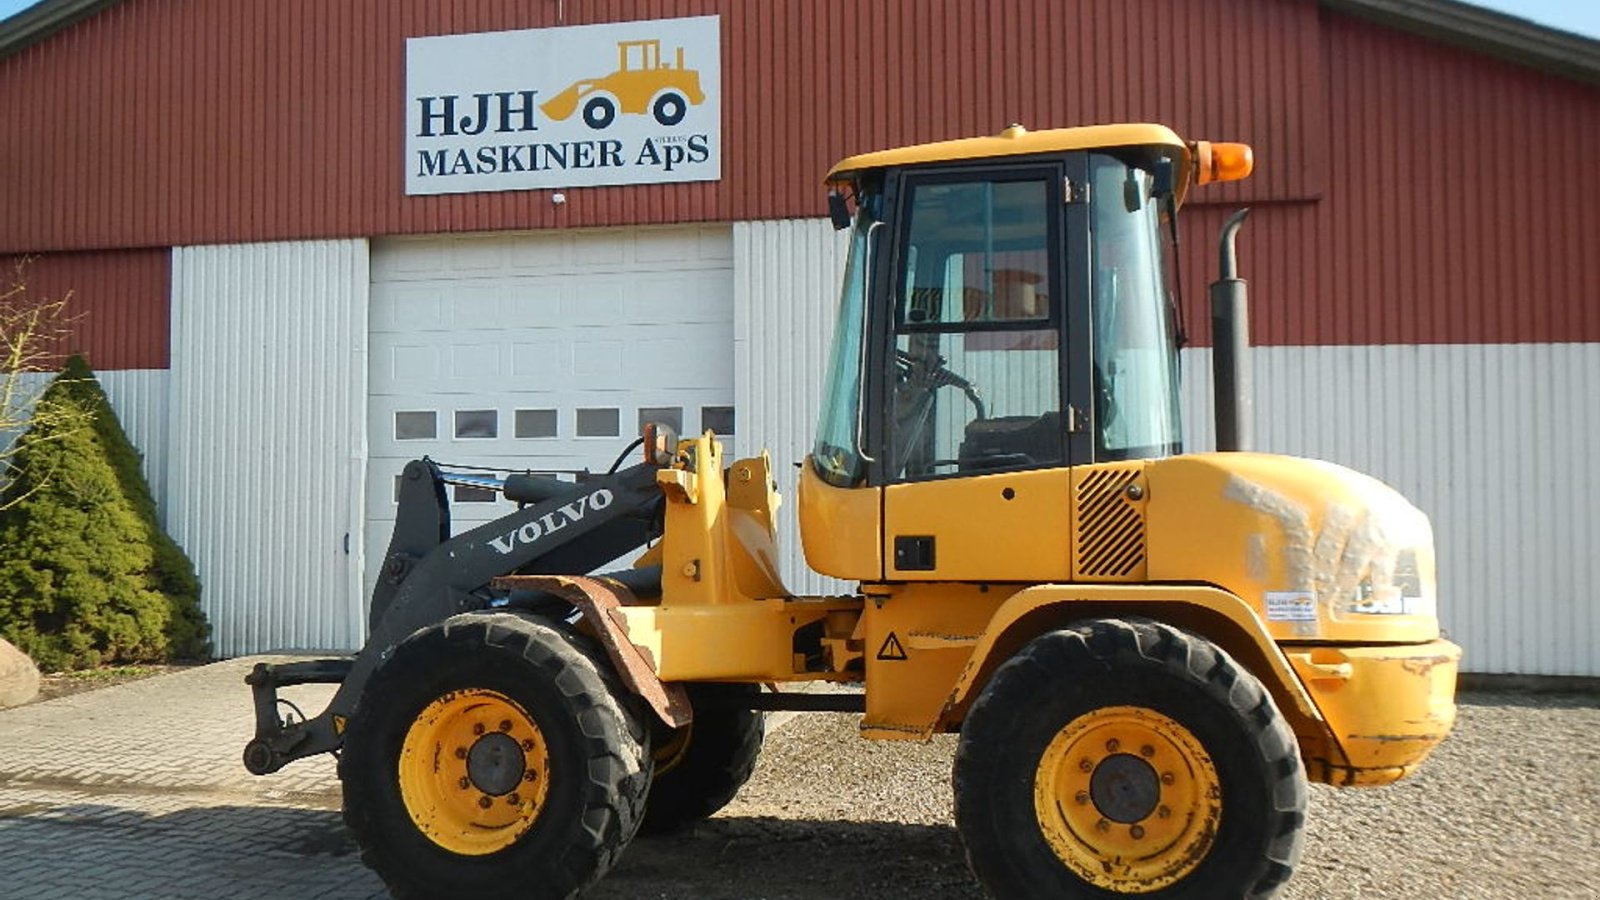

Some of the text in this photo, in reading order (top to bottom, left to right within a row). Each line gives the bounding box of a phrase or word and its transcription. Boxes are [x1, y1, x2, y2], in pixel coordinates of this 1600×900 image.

[416, 90, 538, 137] HJH
[417, 134, 709, 177] MASKINER ApS
[486, 488, 614, 555] VOLVO
